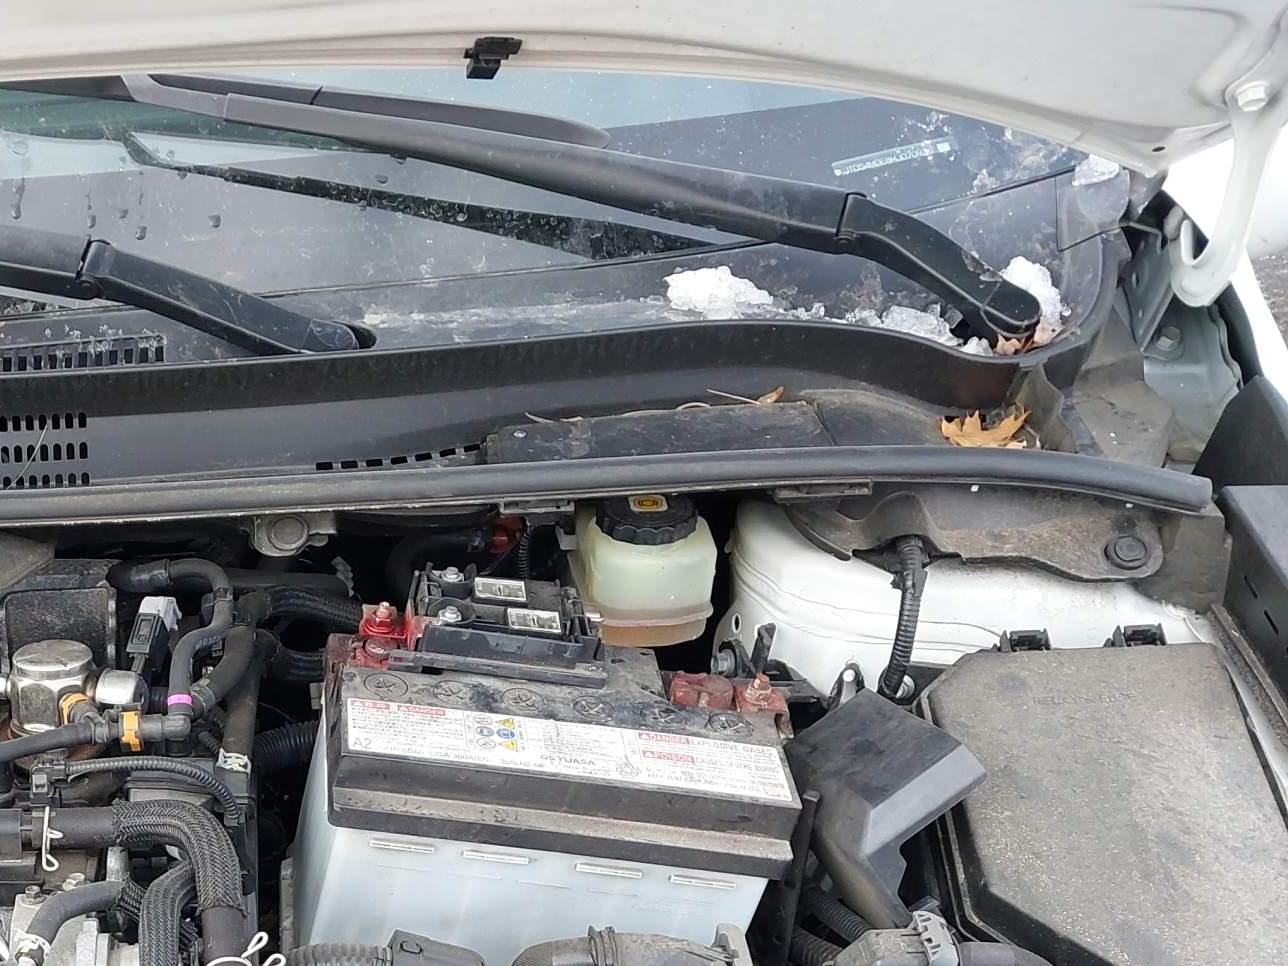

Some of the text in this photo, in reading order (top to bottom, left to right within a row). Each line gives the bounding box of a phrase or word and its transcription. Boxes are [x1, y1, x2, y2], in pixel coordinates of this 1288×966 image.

[408, 706, 445, 716] DANGER
[352, 736, 372, 748] A2
[649, 734, 690, 746] DANGER
[655, 752, 694, 764] POISON
